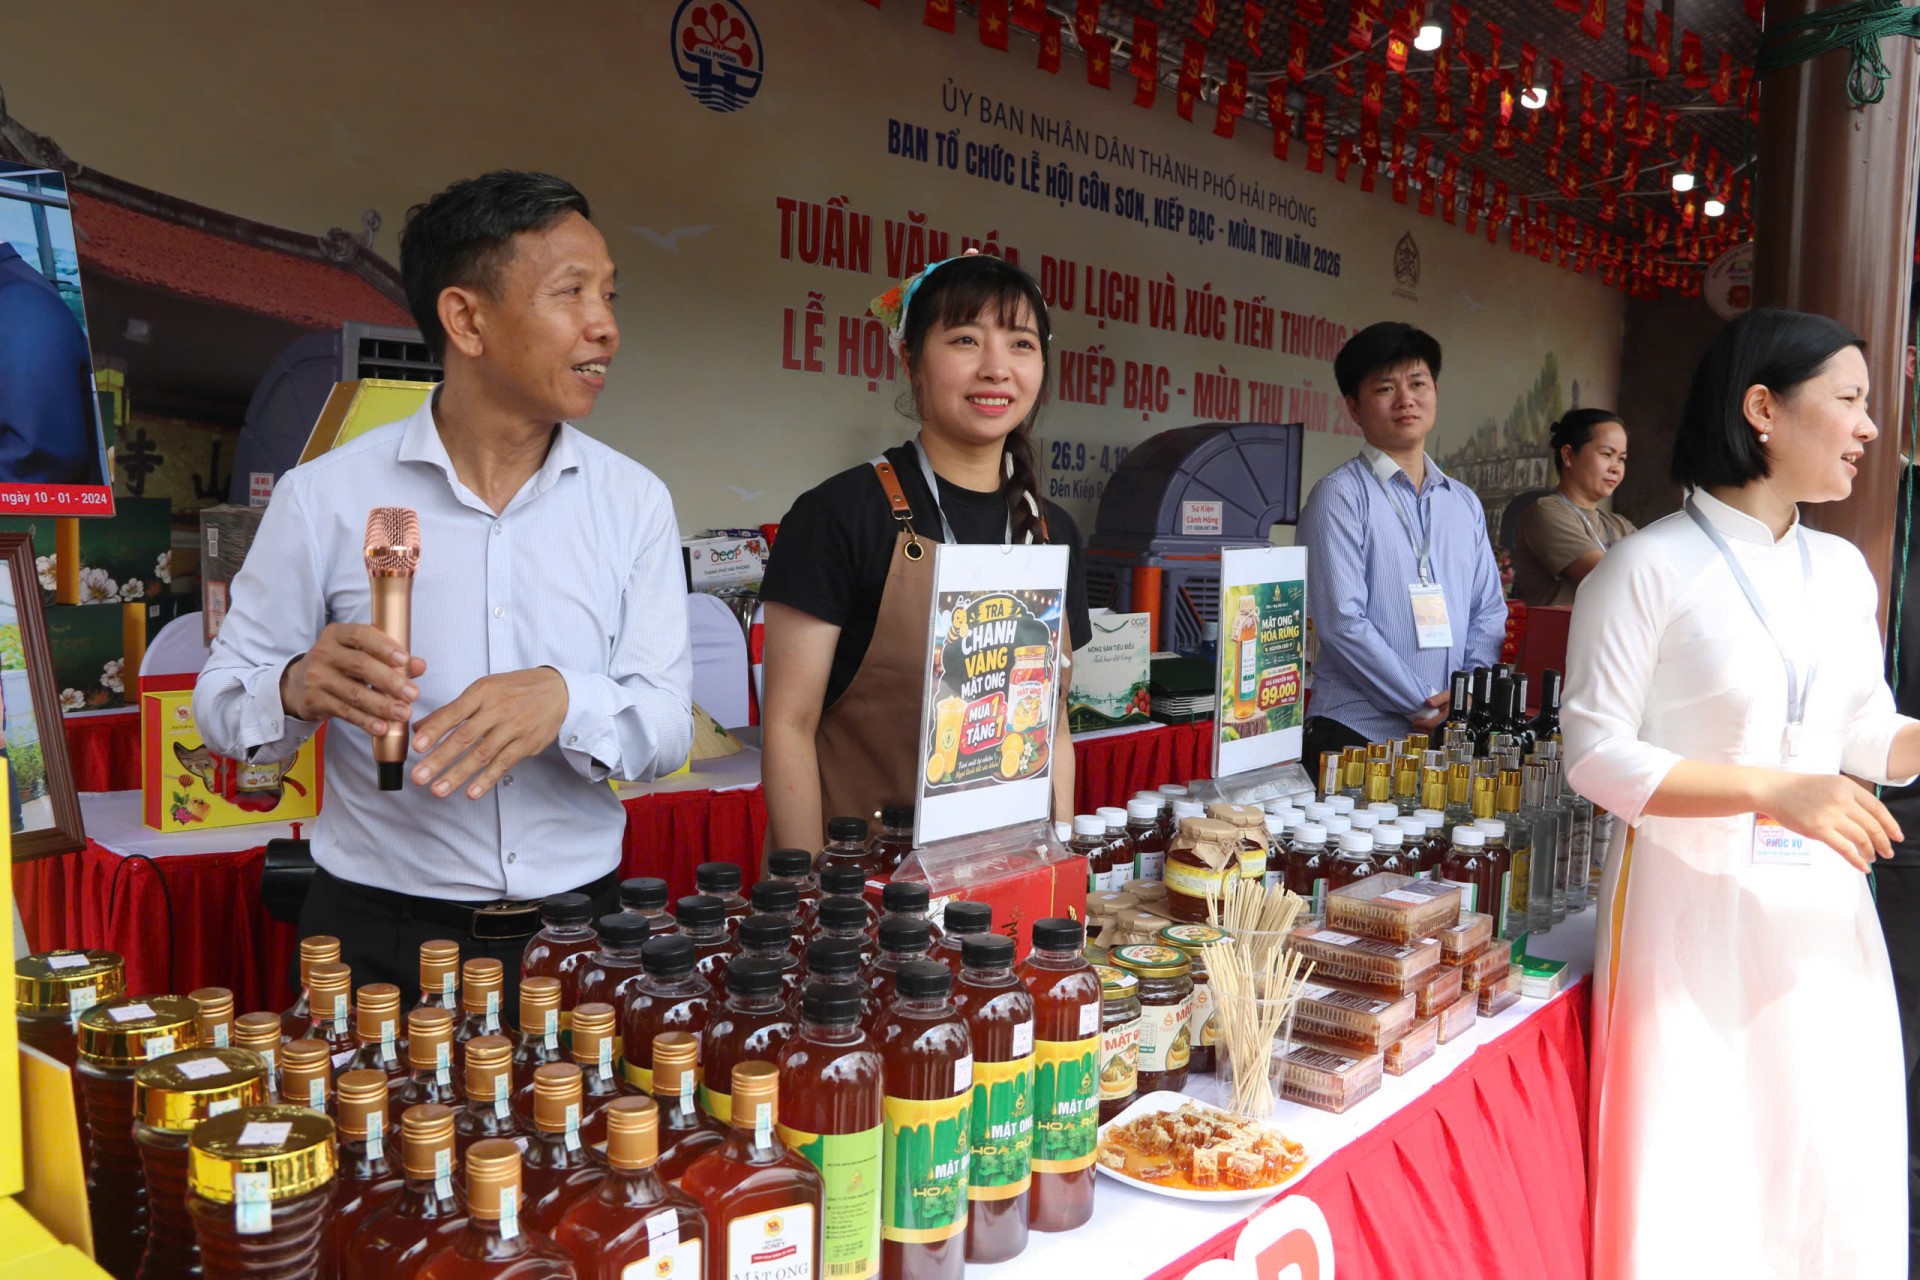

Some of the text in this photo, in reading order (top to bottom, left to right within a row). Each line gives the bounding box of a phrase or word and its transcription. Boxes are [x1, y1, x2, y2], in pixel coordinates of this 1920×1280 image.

[942, 78, 1317, 227] ỦY BAN NHÂN DÂN THÀNH PHỐ HẢI PHÒNG
[888, 118, 928, 163] BAN
[936, 128, 960, 170] TỔ
[965, 141, 1015, 185] CHỨC
[1021, 150, 1040, 193] LỄ
[1046, 162, 1073, 207] HỘI
[1079, 170, 1110, 212] CÔN
[1115, 186, 1149, 228] SƠN,
[1154, 197, 1184, 233] KIẾP
[1189, 208, 1215, 244] BẠC
[1228, 217, 1256, 254] MÙA
[1260, 229, 1282, 260] THU
[1285, 233, 1311, 268] NĂM
[1314, 246, 1341, 278] 2026
[776, 195, 872, 274] TUẦN
[1040, 254, 1075, 311] DU
[1085, 265, 1140, 329] LỊCH
[1148, 272, 1176, 332] VÀ
[1184, 282, 1226, 341] XÚC
[1233, 295, 1275, 350] TIẾN
[1281, 310, 1347, 362] THƯƠNG
[782, 291, 825, 373] LỄ
[1059, 344, 1115, 405] KIẾP
[1123, 360, 1170, 421] BẠC
[1193, 364, 1240, 421] MÙA
[1249, 381, 1283, 423] THU
[1290, 378, 1328, 433] NĂM
[1051, 441, 1086, 472] 26.9
[1, 490, 31, 505] ngày
[34, 492, 47, 503] 10
[58, 492, 71, 504] 01
[81, 492, 107, 504] 2024
[985, 600, 1004, 618] TRÀ
[1262, 615, 1293, 631] MẬT ONG
[961, 620, 1017, 656] CHANH
[1260, 626, 1300, 643] HOA RỪNG
[965, 646, 1008, 679] VÀNG
[961, 671, 1006, 699] MẬT ONG
[1261, 681, 1296, 707] 99.000
[968, 696, 999, 723] MUA 1
[966, 720, 1004, 745] TẶNG 1
[1105, 1032, 1132, 1050] MẬT
[1058, 1098, 1083, 1117] MẬT
[991, 1121, 1017, 1140] MẬT
[1038, 1121, 1075, 1130] HOA
[970, 1145, 1009, 1155] HOA
[935, 1159, 959, 1179] MẬT
[914, 1184, 952, 1197] HOA
[775, 1263, 808, 1280] ONG
